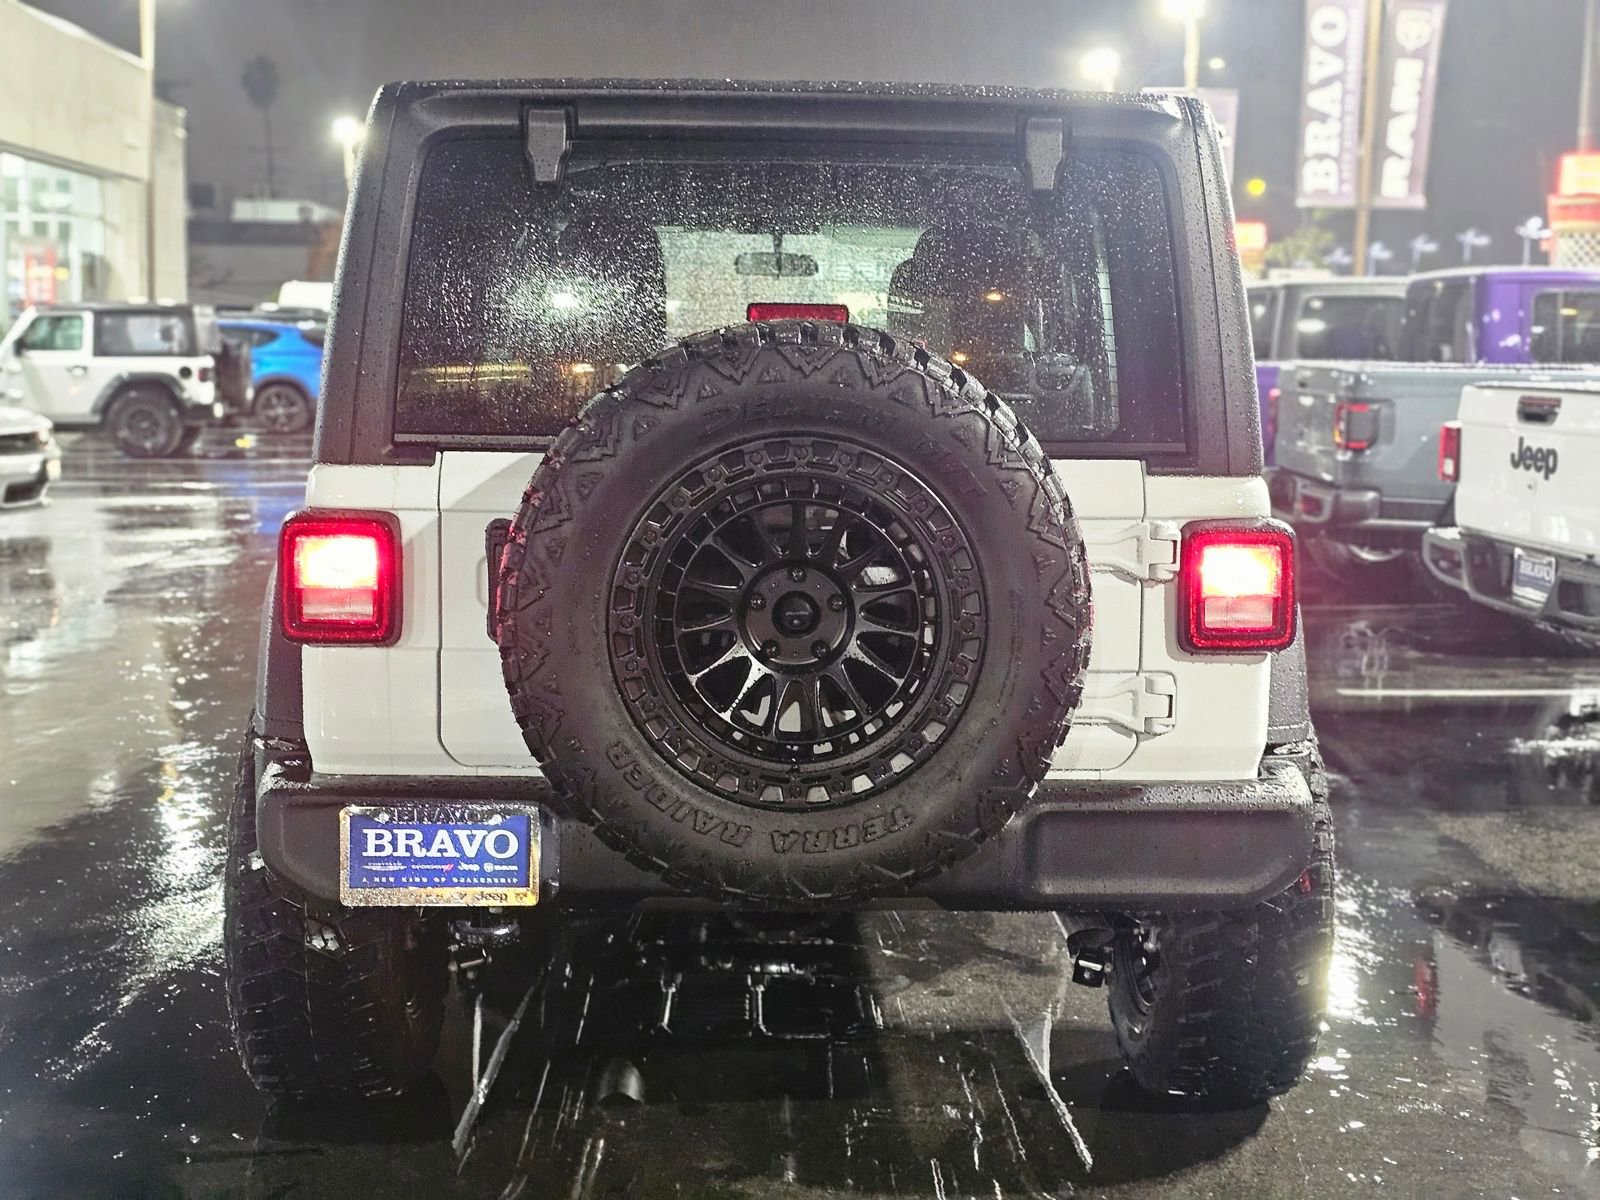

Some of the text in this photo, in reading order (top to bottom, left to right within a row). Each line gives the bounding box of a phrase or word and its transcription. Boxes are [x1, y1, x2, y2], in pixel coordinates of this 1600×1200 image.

[1302, 5, 1347, 196] BRAVO
[1380, 57, 1425, 199] RAM
[1510, 436, 1558, 480] Jeep
[606, 741, 915, 854] TERRA RAIDER
[361, 828, 519, 859] BRAVO
[475, 890, 508, 902] Jeep
